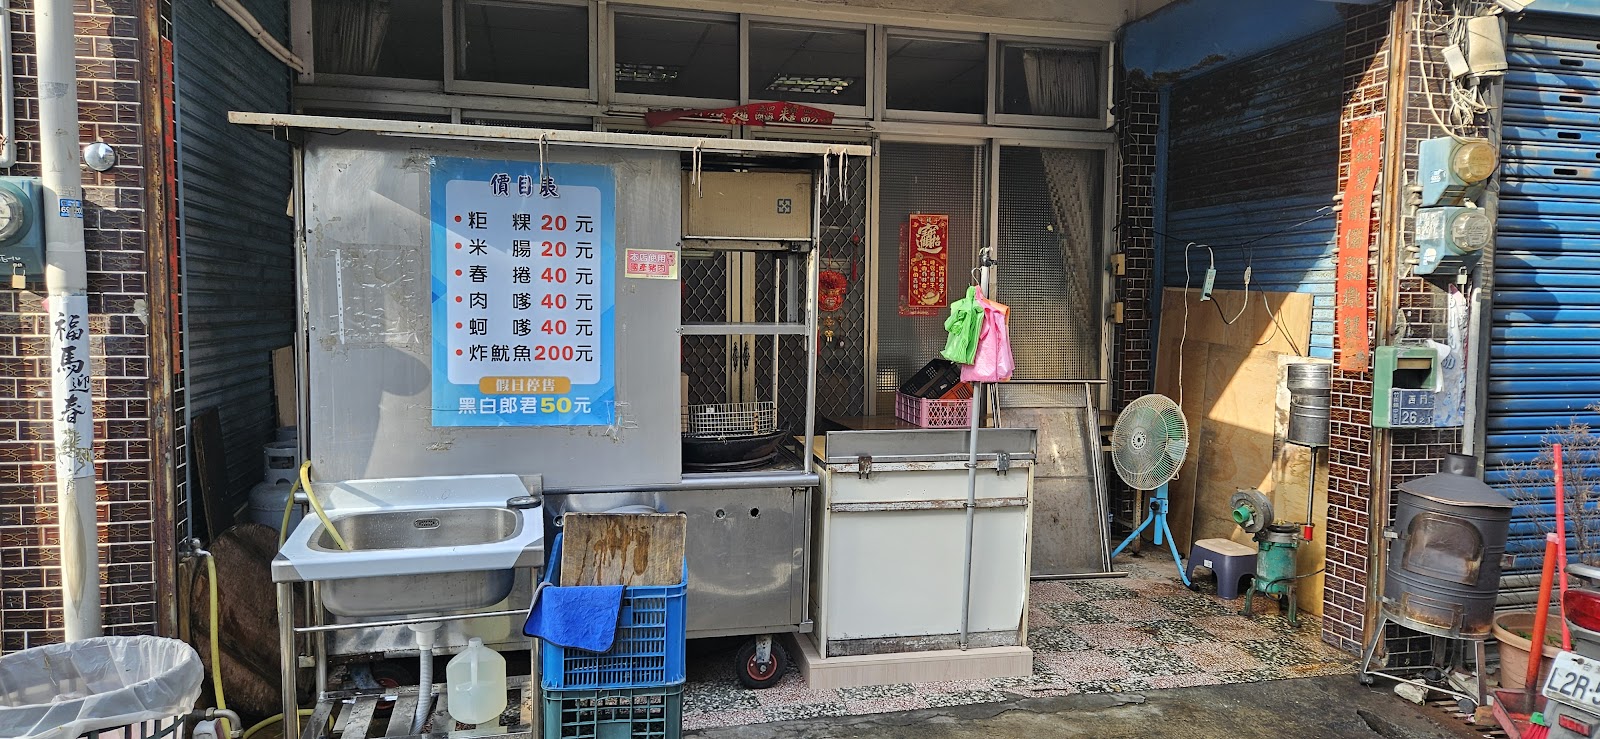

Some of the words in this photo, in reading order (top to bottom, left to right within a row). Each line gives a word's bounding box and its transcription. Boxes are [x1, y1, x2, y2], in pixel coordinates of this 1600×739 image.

[489, 172, 560, 198] 價目表
[630, 252, 666, 263] 本店使用
[630, 263, 666, 272] 國產豬肉
[495, 378, 555, 392] 假日停售
